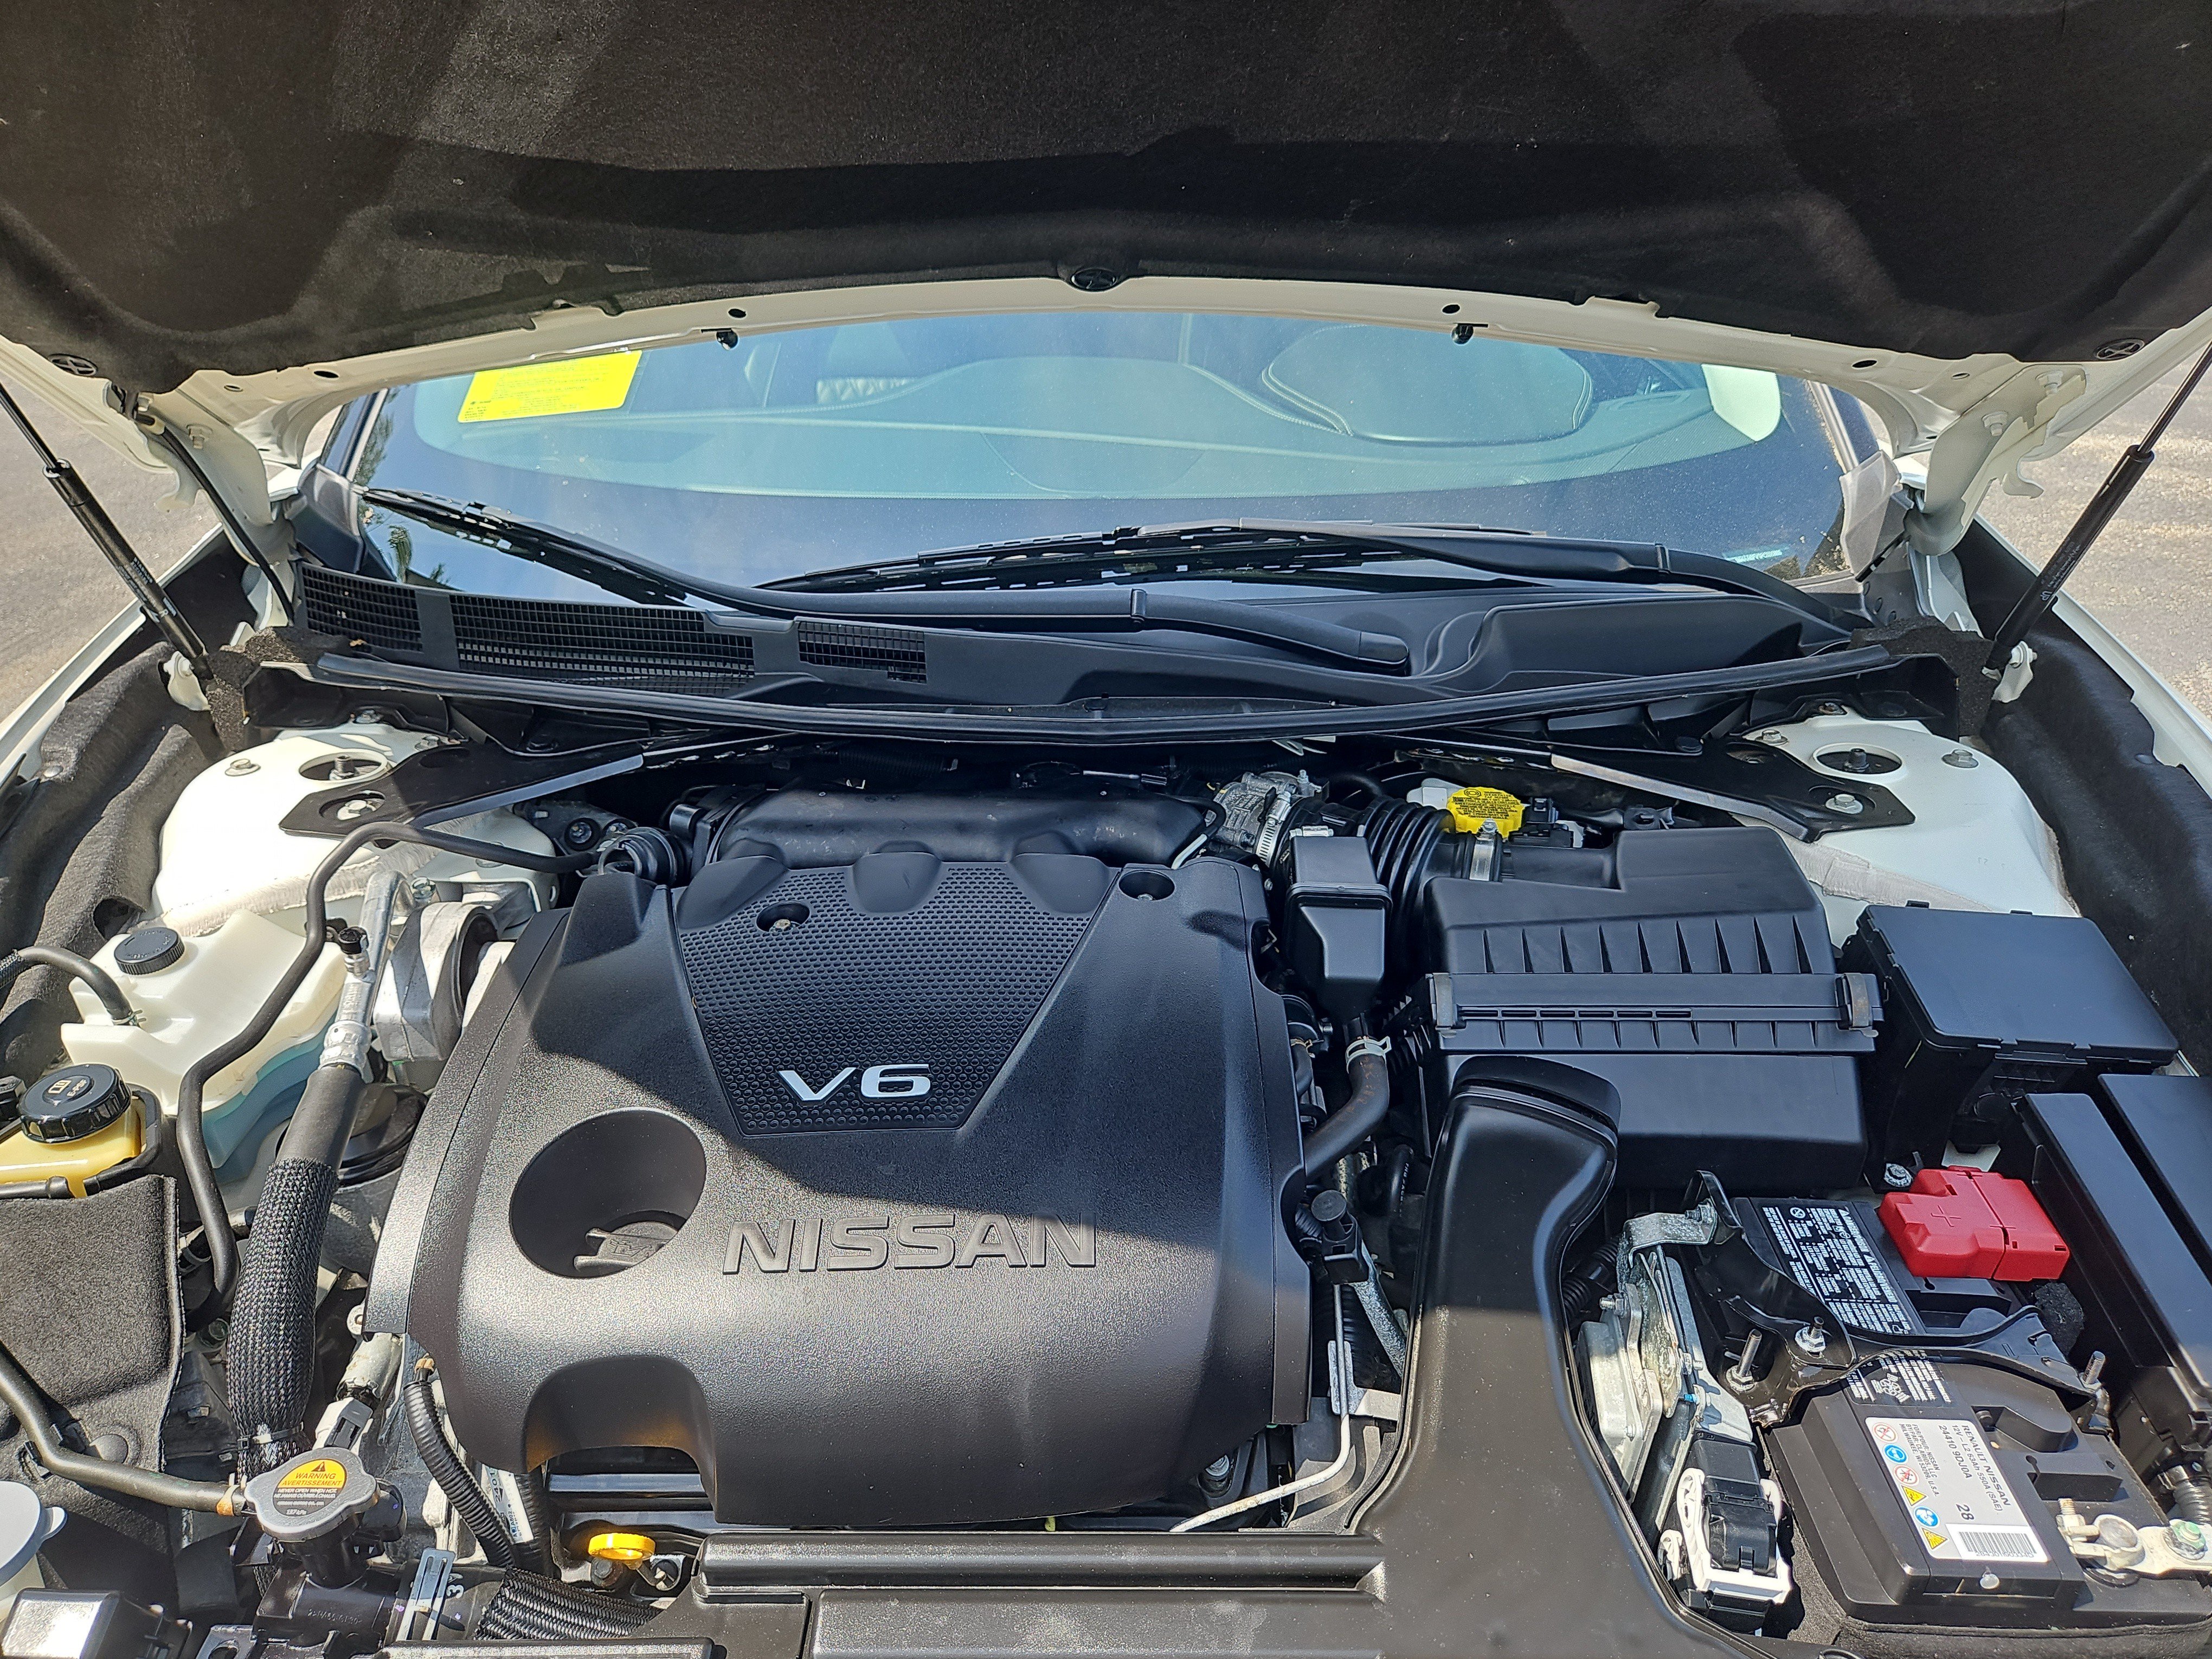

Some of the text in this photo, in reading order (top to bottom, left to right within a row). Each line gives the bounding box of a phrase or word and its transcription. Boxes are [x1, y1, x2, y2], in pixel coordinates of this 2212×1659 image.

[779, 1063, 931, 1102] V6
[722, 1213, 1097, 1274] NISSAN
[1898, 1423, 1919, 1454] MILWAUKEE,
[1917, 1462, 1932, 1480] 53209,
[1927, 1480, 1940, 1497] U.S.A.
[1905, 1424, 1920, 1443] BY/PAR:
[1927, 1468, 1938, 1477] LLC
[1911, 1424, 1940, 1470] FOR/POUR: NISSAN
[1937, 1425, 1958, 1449] 24410
[1951, 1424, 1963, 1436] 12V
[1960, 1443, 1971, 1451] L2
[1966, 1453, 1982, 1470] 63Ah
[1976, 1472, 1992, 1489] 550A
[1984, 1491, 2004, 1512] (SAE)
[1960, 1425, 2011, 1506] RENAULT NISSAN
[1954, 1503, 1976, 1520] 28
